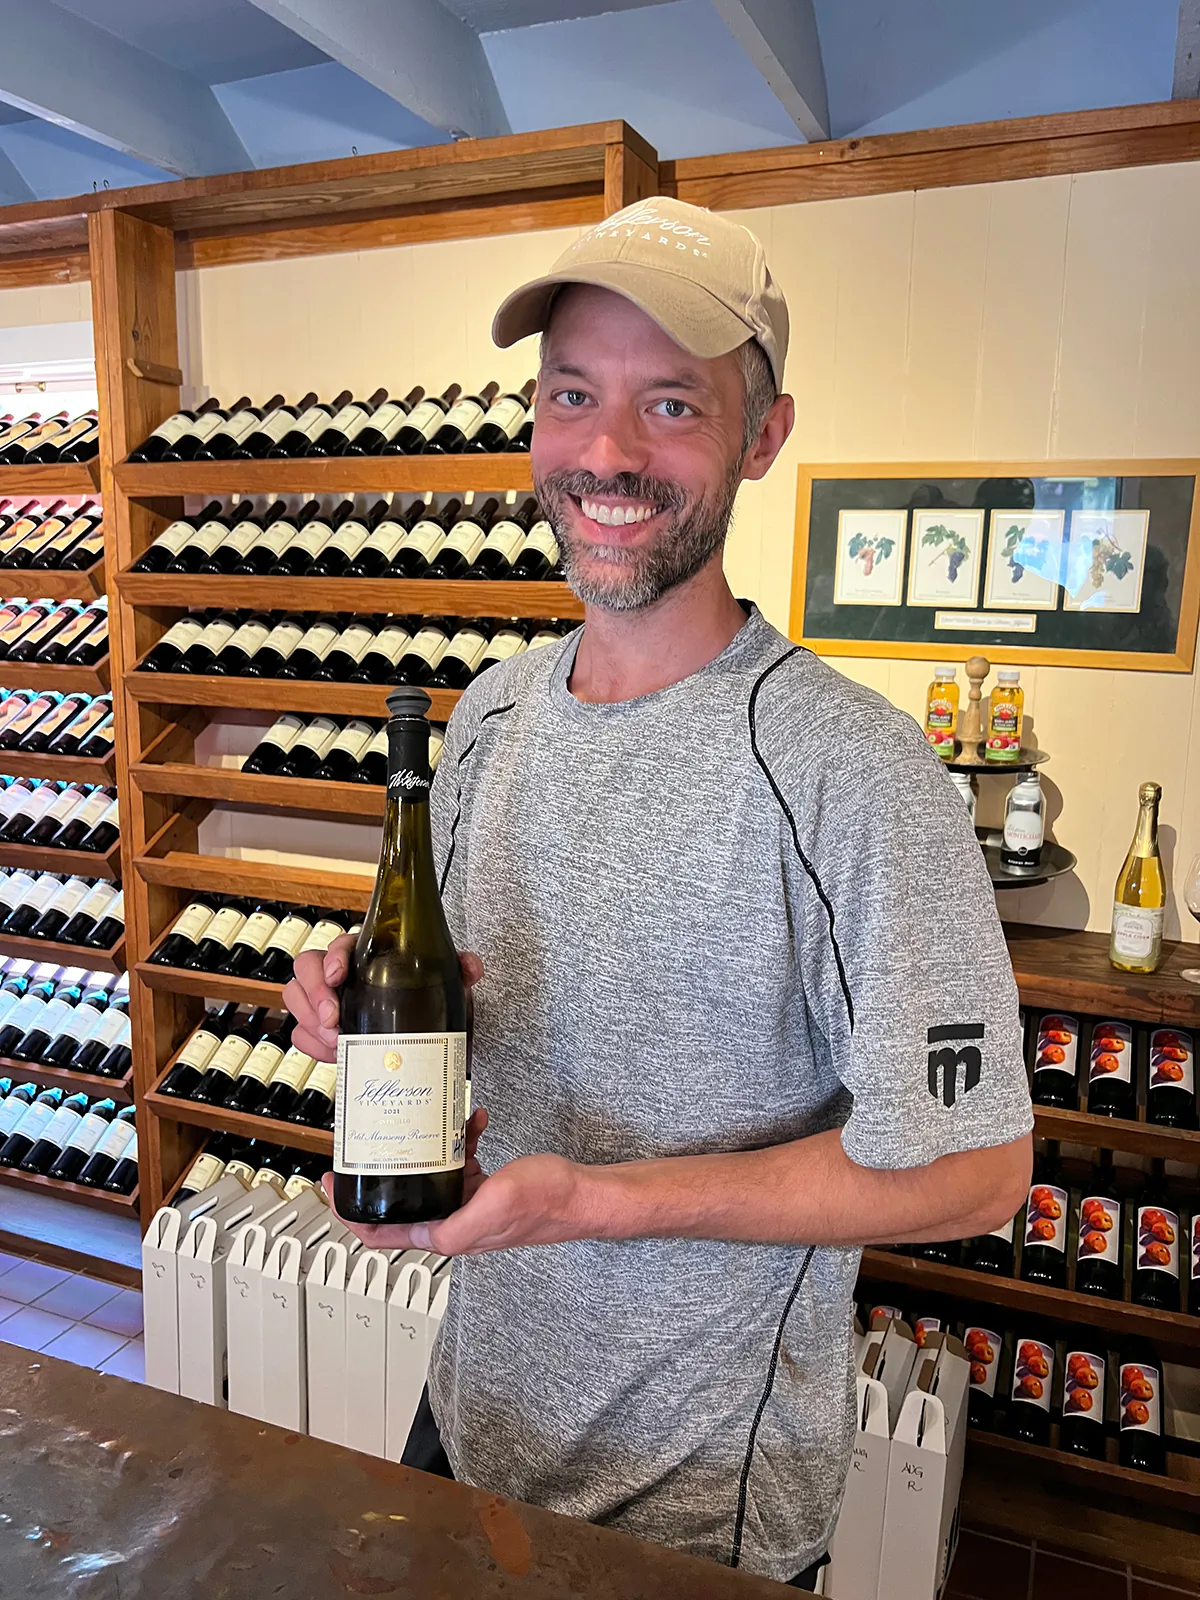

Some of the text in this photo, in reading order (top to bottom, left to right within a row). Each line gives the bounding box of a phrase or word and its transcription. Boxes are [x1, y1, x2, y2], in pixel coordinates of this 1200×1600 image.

[354, 1078, 434, 1102] Jefferson
[347, 1129, 365, 1140] Petit
[407, 1127, 441, 1140] Reserve
[907, 1480, 923, 1492] R
